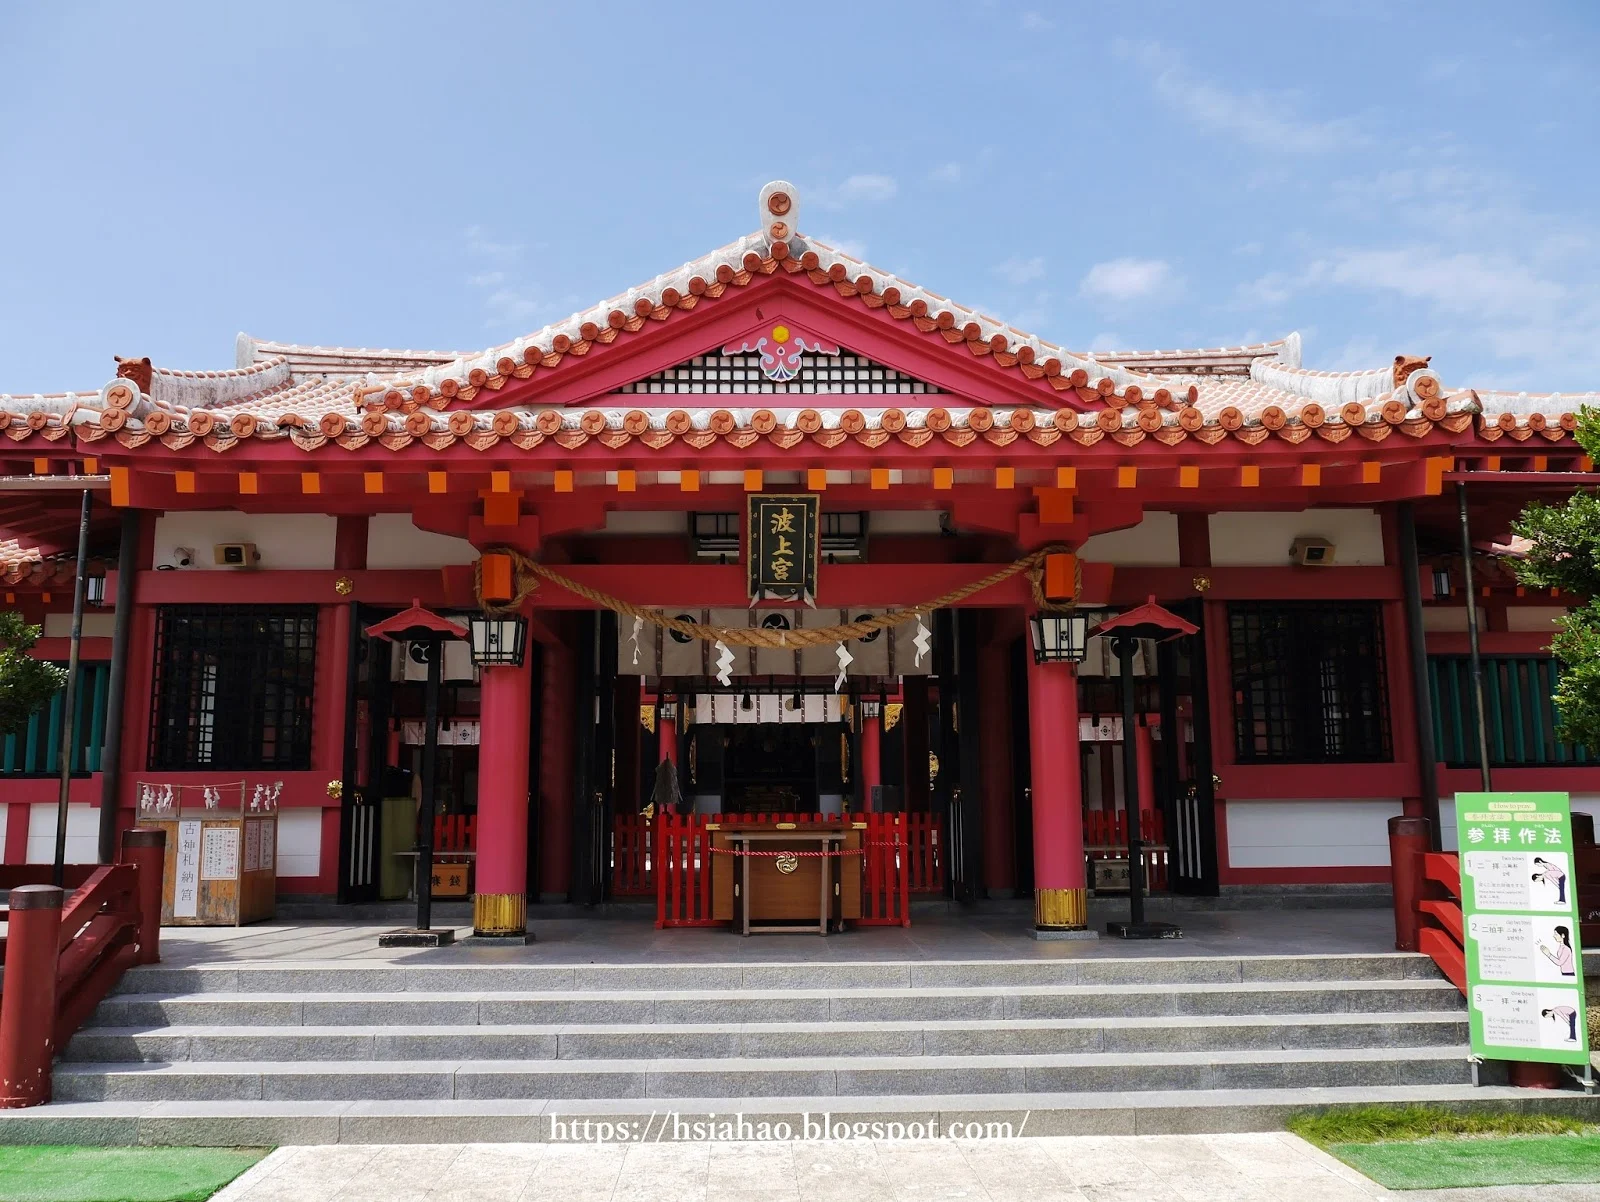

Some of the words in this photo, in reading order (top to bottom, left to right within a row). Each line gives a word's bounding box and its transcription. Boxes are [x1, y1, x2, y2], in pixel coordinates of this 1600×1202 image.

[770, 507, 796, 581] 波上宮
[1467, 827, 1563, 844] 参拝作法
[1467, 859, 1472, 868] 1
[1471, 922, 1478, 932] 2
[1476, 993, 1482, 1002] 3
